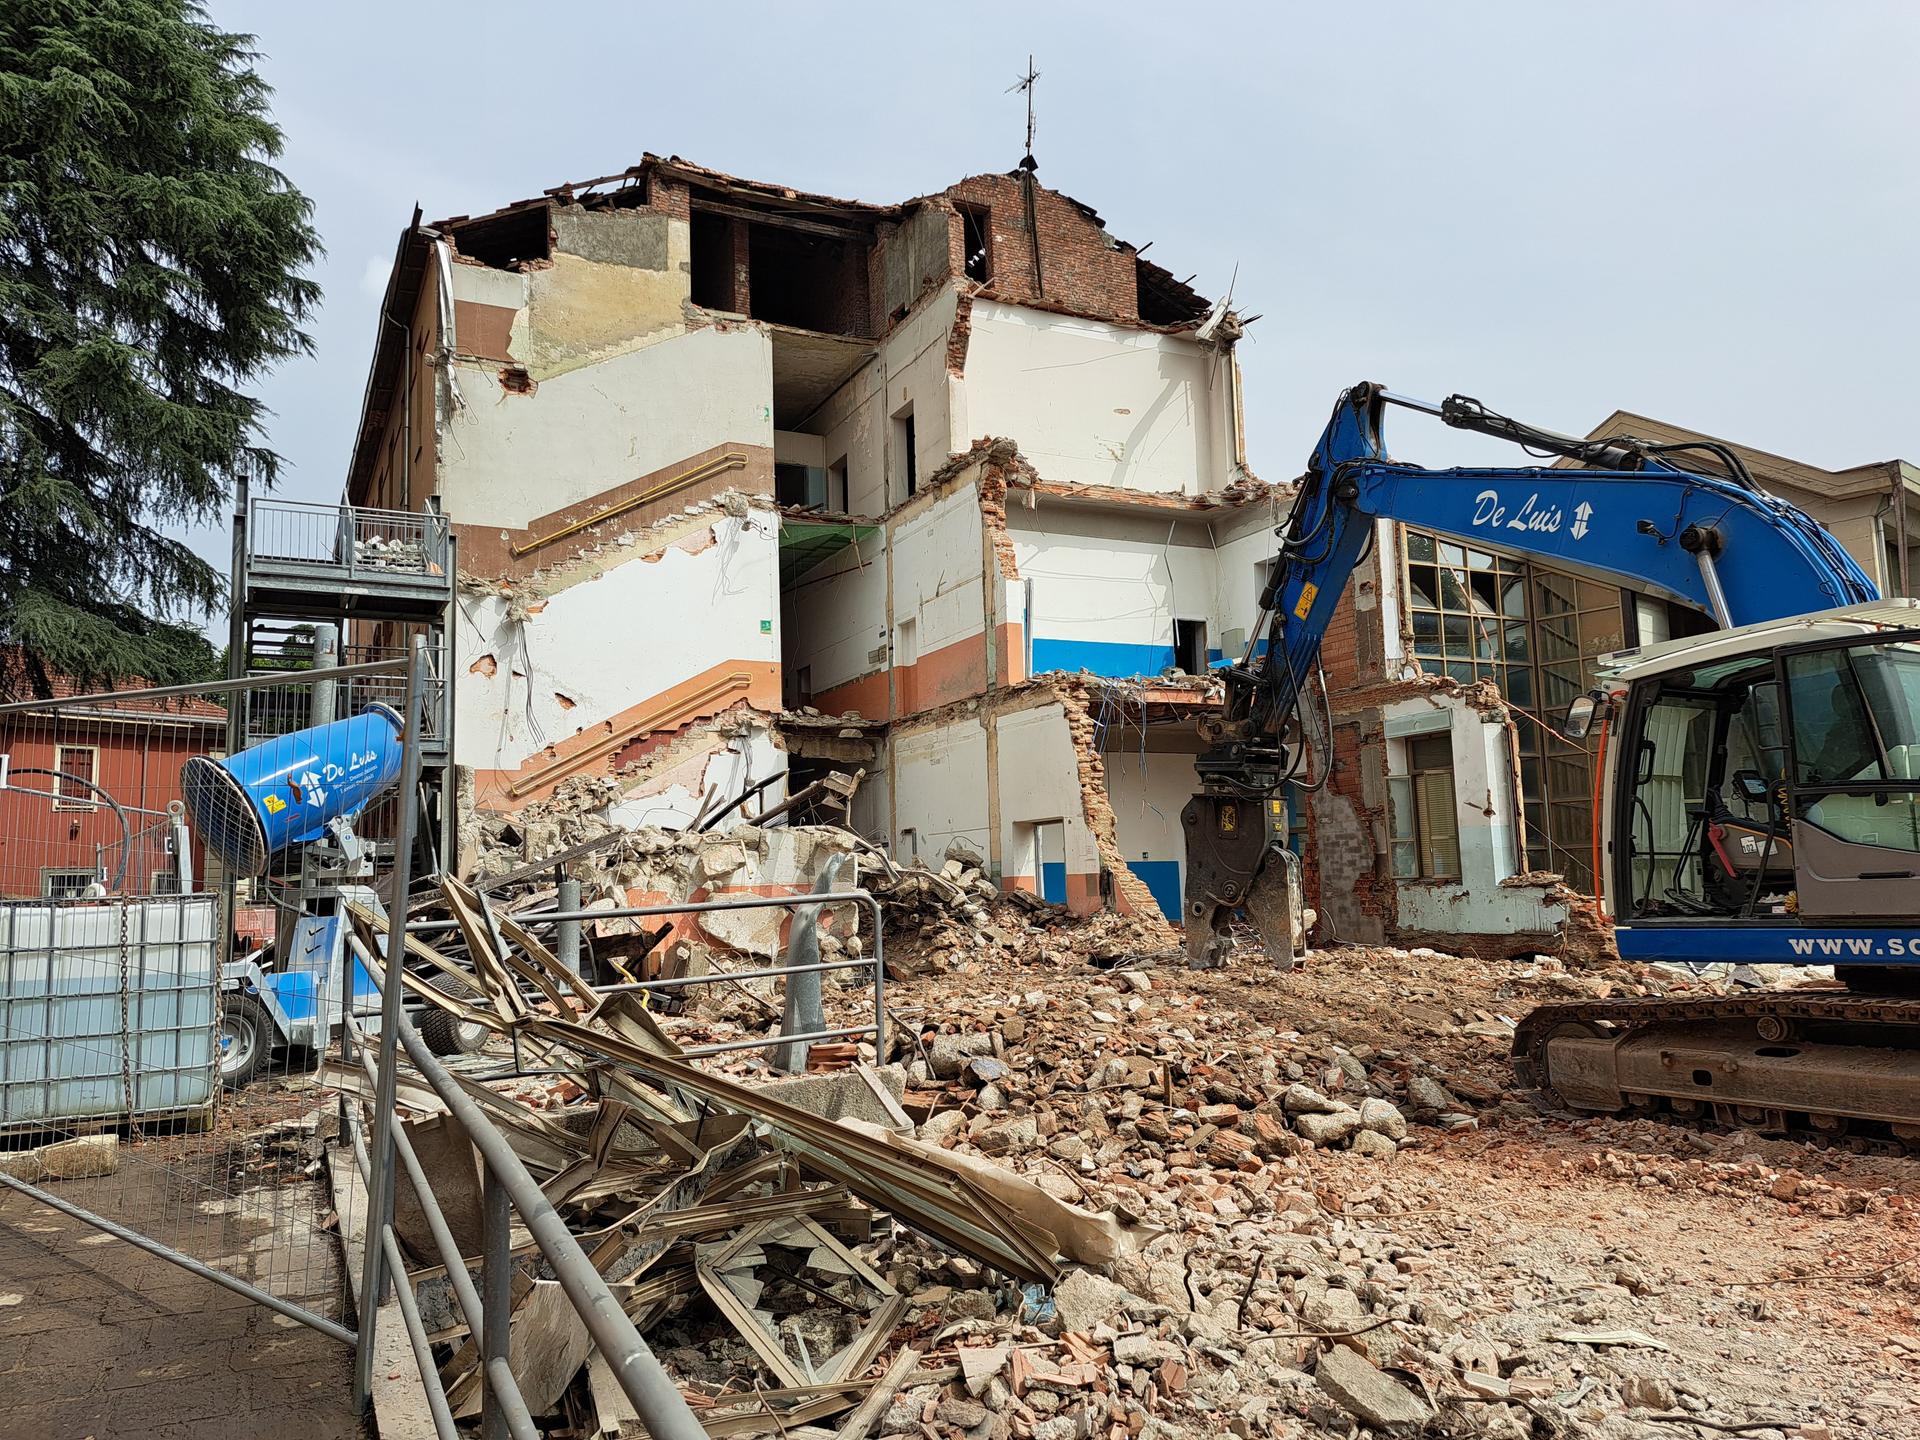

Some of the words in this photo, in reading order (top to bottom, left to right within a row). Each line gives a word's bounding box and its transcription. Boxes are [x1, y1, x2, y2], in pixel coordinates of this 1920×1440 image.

[1472, 489, 1506, 527] De
[1506, 493, 1562, 533] Luis
[322, 763, 345, 782] De
[349, 750, 378, 772] Luis
